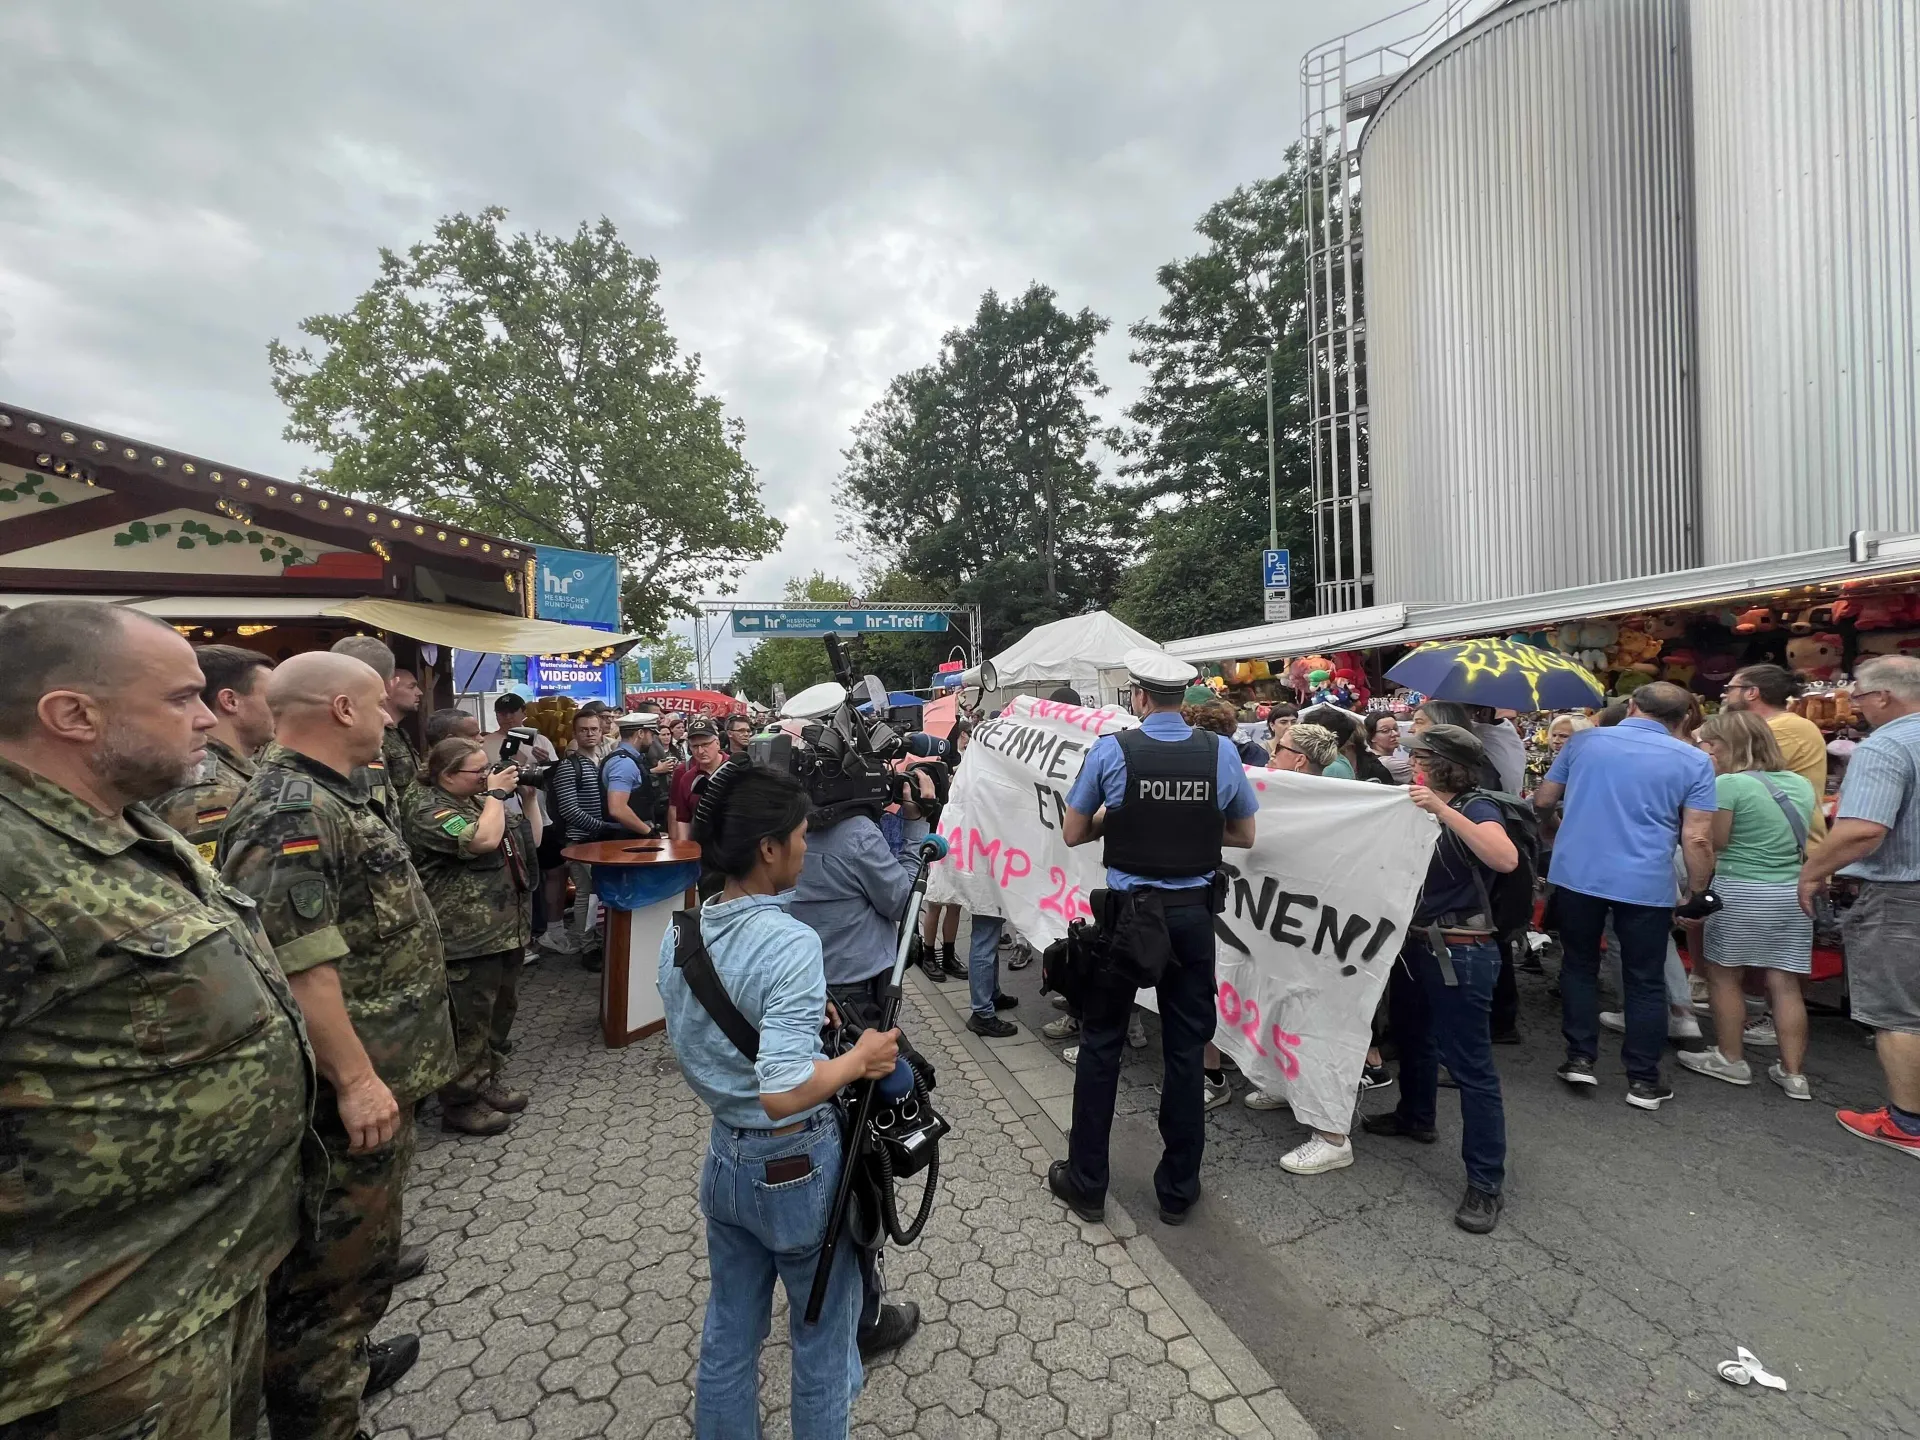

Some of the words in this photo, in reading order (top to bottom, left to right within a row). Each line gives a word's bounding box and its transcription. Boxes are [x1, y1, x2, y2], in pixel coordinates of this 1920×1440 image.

[1268, 552, 1278, 568] P
[543, 567, 573, 594] hr
[544, 594, 590, 604] HESSISCHER
[544, 601, 585, 610] RUNDFUNK
[764, 614, 780, 628] hr
[866, 614, 924, 628] hr-Treff
[540, 661, 572, 669] Wettervideo
[540, 670, 603, 682] VIDEOBOX
[1028, 699, 1117, 735] NACH
[973, 719, 1092, 780] HEINME
[1140, 780, 1210, 801] POLIZEI
[938, 819, 1032, 888] AMP
[1214, 860, 1396, 977] NEN!
